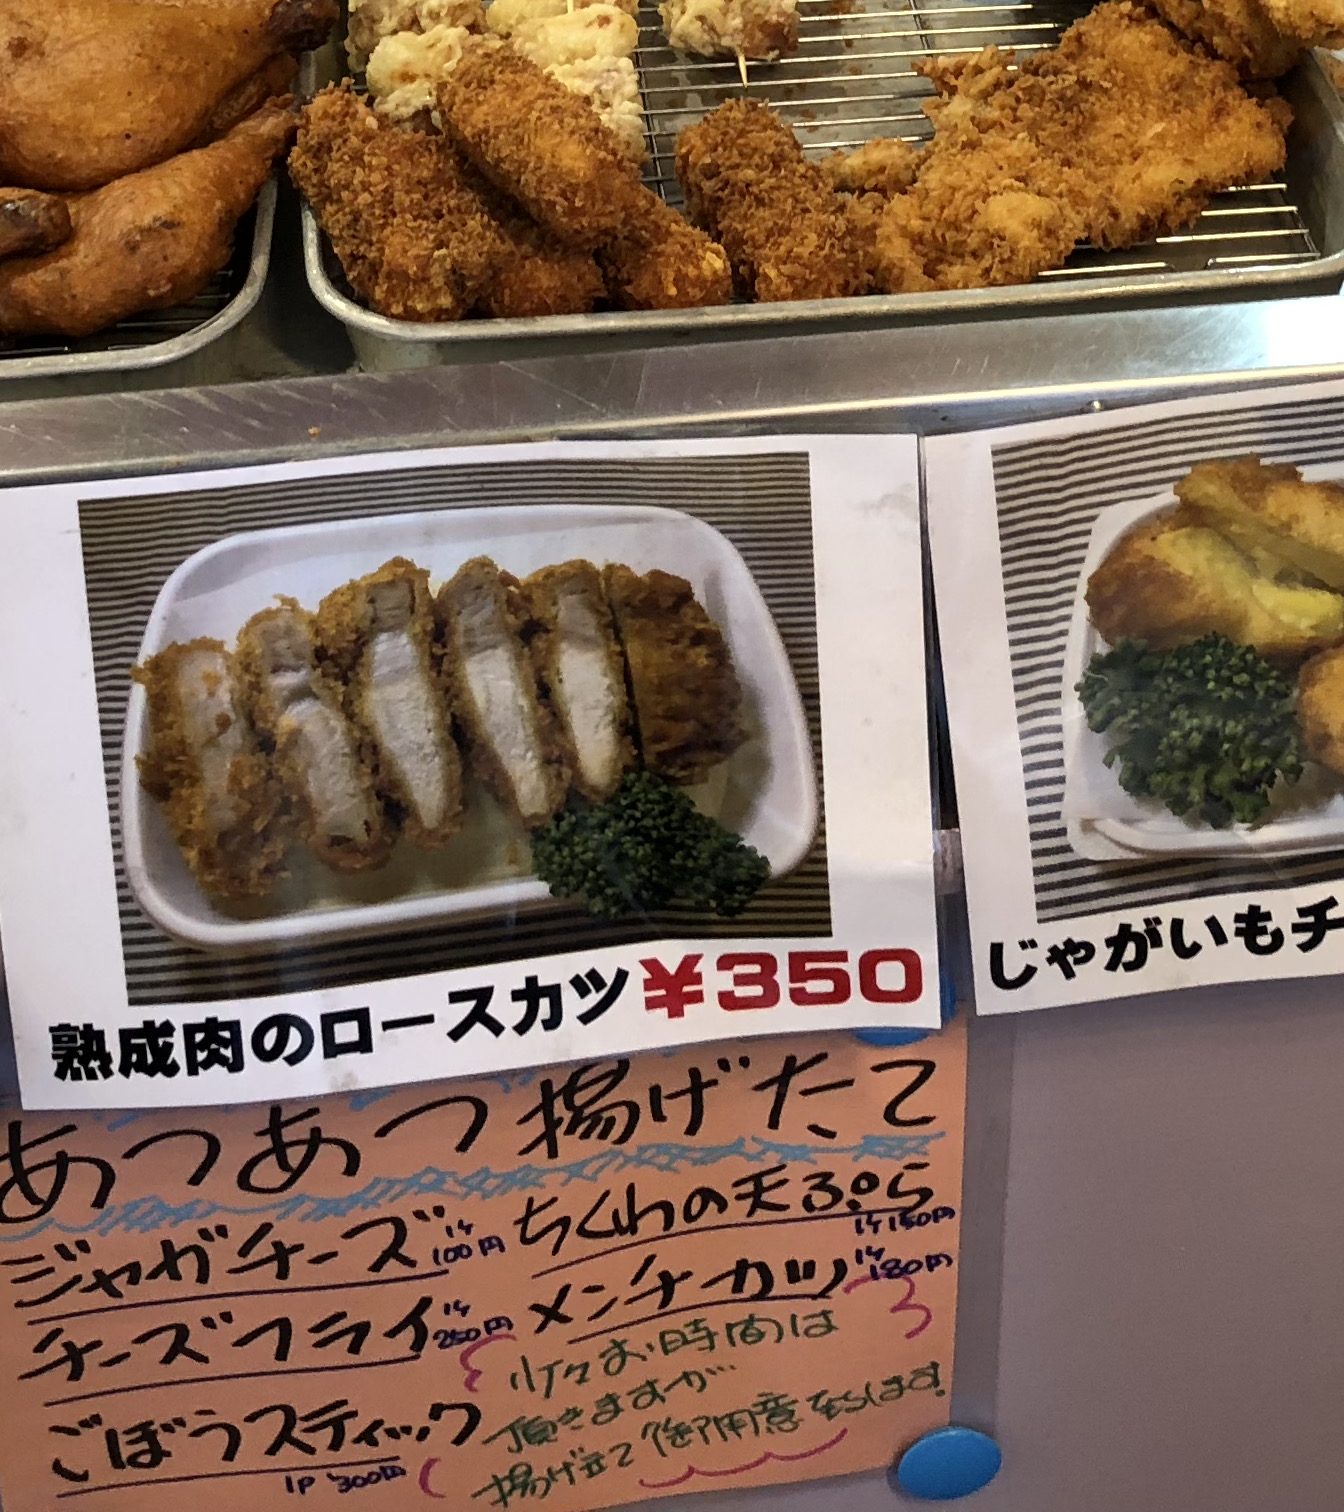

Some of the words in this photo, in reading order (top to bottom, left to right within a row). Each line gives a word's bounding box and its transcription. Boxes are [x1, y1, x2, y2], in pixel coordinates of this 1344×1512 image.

[49, 964, 633, 1082] 熟成肉のロースカツ
[640, 947, 924, 1022] ¥350
[514, 1161, 935, 1256] ちくわの天ぷら
[0, 1205, 444, 1308] ジャガチーズ
[529, 1253, 848, 1335] メンチカツ
[17, 1296, 433, 1382] チーズフライ
[48, 1399, 483, 1484] ごぼうスティック
